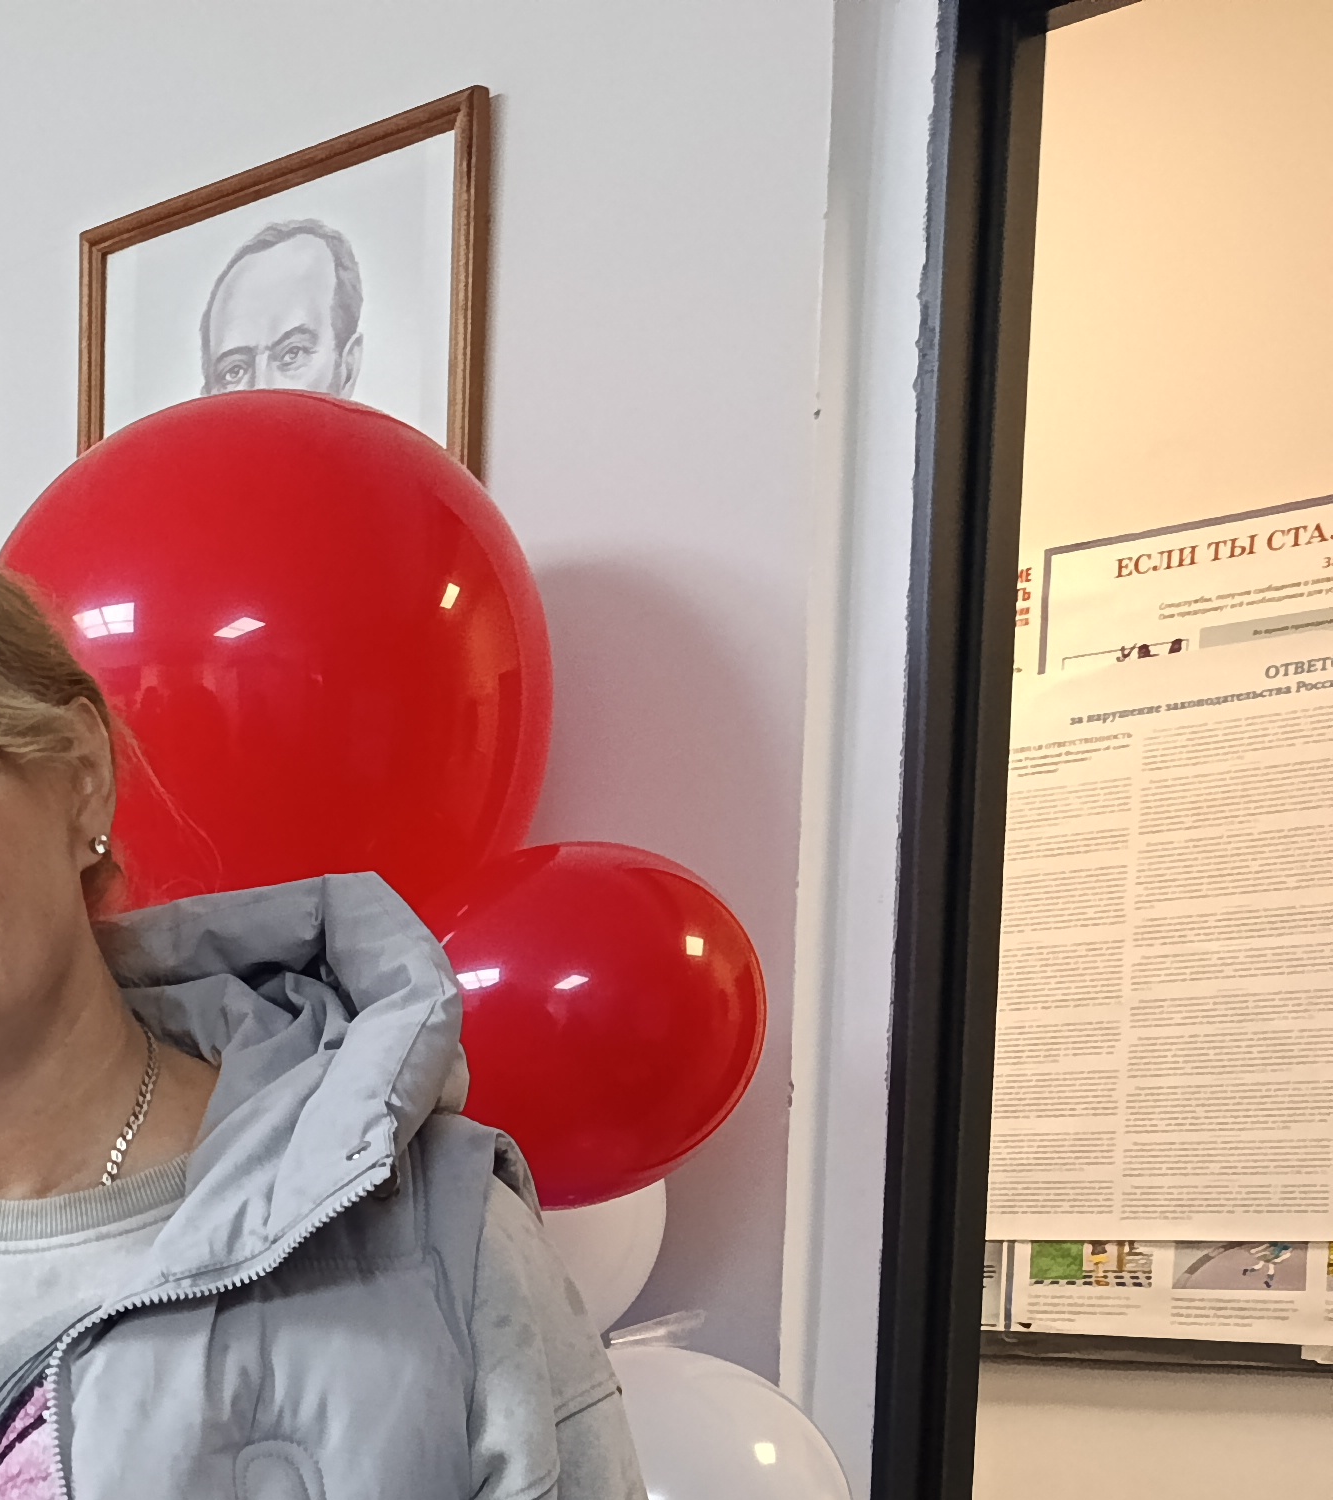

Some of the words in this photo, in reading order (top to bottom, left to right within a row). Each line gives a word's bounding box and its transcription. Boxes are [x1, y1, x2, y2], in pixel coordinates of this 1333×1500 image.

[1115, 545, 1199, 578] ЕСЛИ
[1207, 533, 1259, 562] ТЫ
[1267, 522, 1333, 551] СТА
[1265, 656, 1333, 679] ОТВЕТ
[1087, 702, 1161, 723] нарушение
